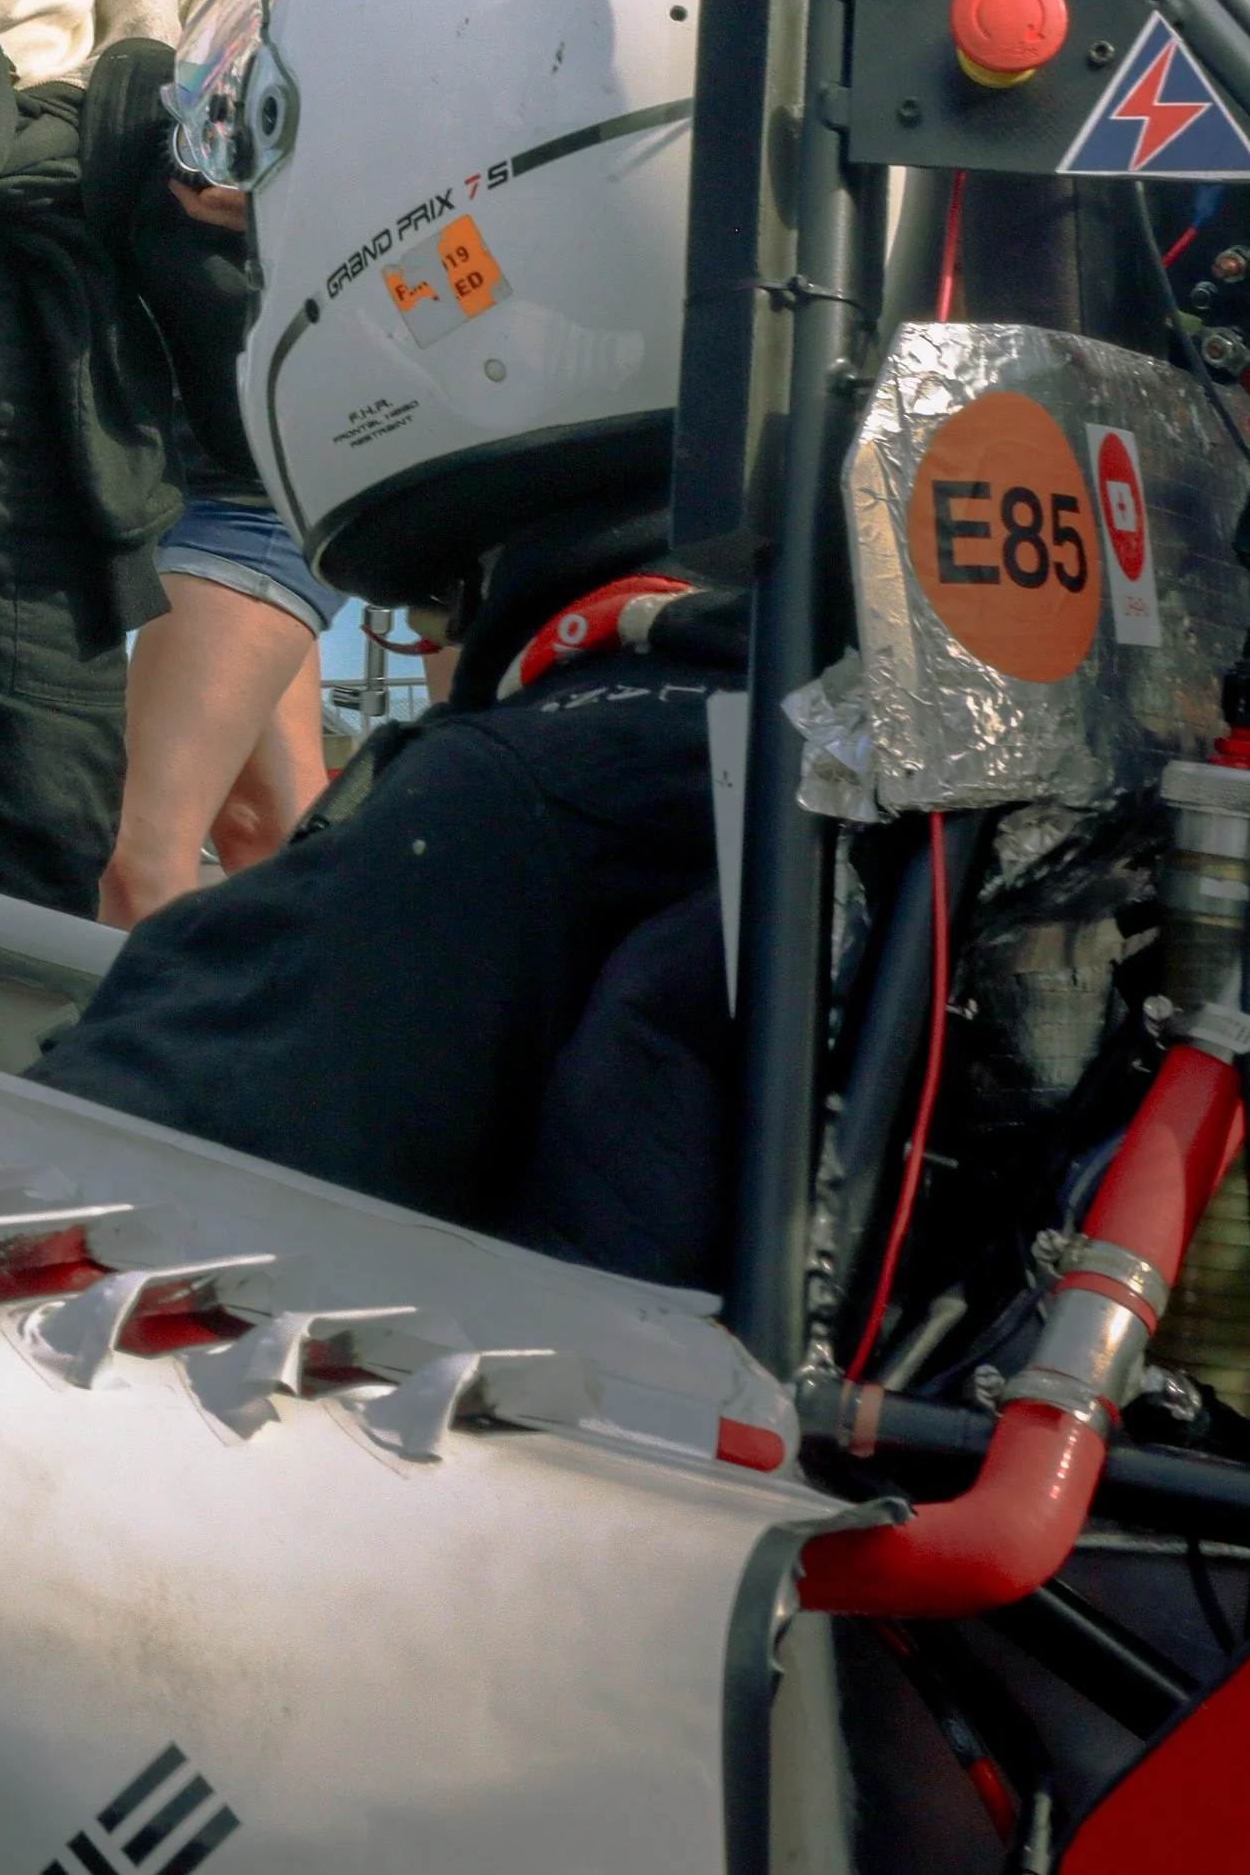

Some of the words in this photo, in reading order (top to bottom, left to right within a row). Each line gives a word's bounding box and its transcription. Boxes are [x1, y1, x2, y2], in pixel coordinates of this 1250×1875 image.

[326, 229, 393, 299] GRAND
[396, 187, 456, 241] PRIX
[930, 479, 1090, 595] E85
